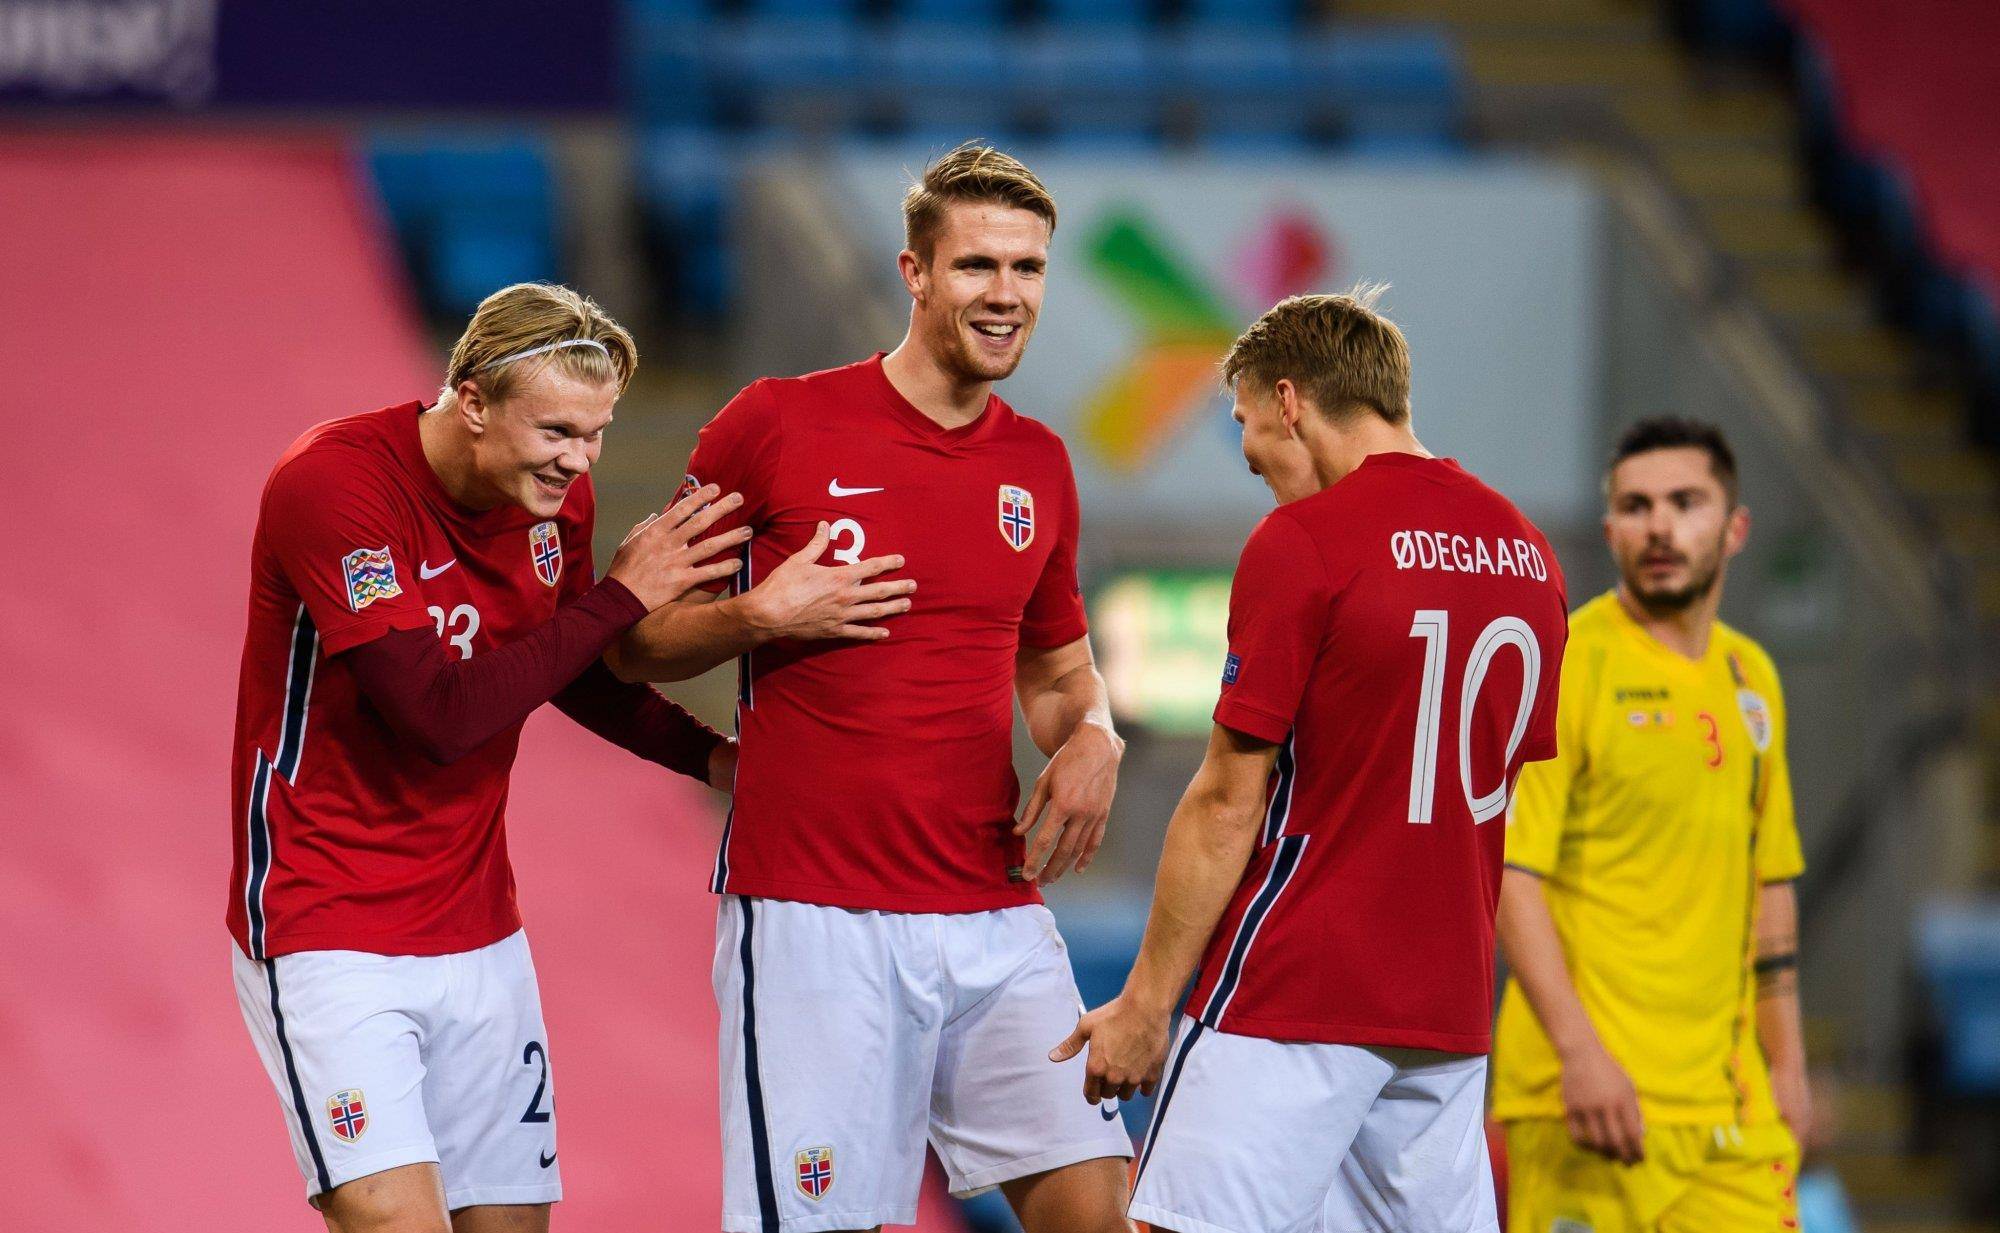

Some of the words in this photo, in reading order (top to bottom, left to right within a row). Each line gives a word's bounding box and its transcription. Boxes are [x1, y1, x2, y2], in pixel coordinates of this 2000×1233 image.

[1390, 530, 1547, 582] ØDEGAARD
[1408, 609, 1541, 825] 10
[1698, 712, 1723, 768] 3
[519, 1040, 555, 1123] 2
